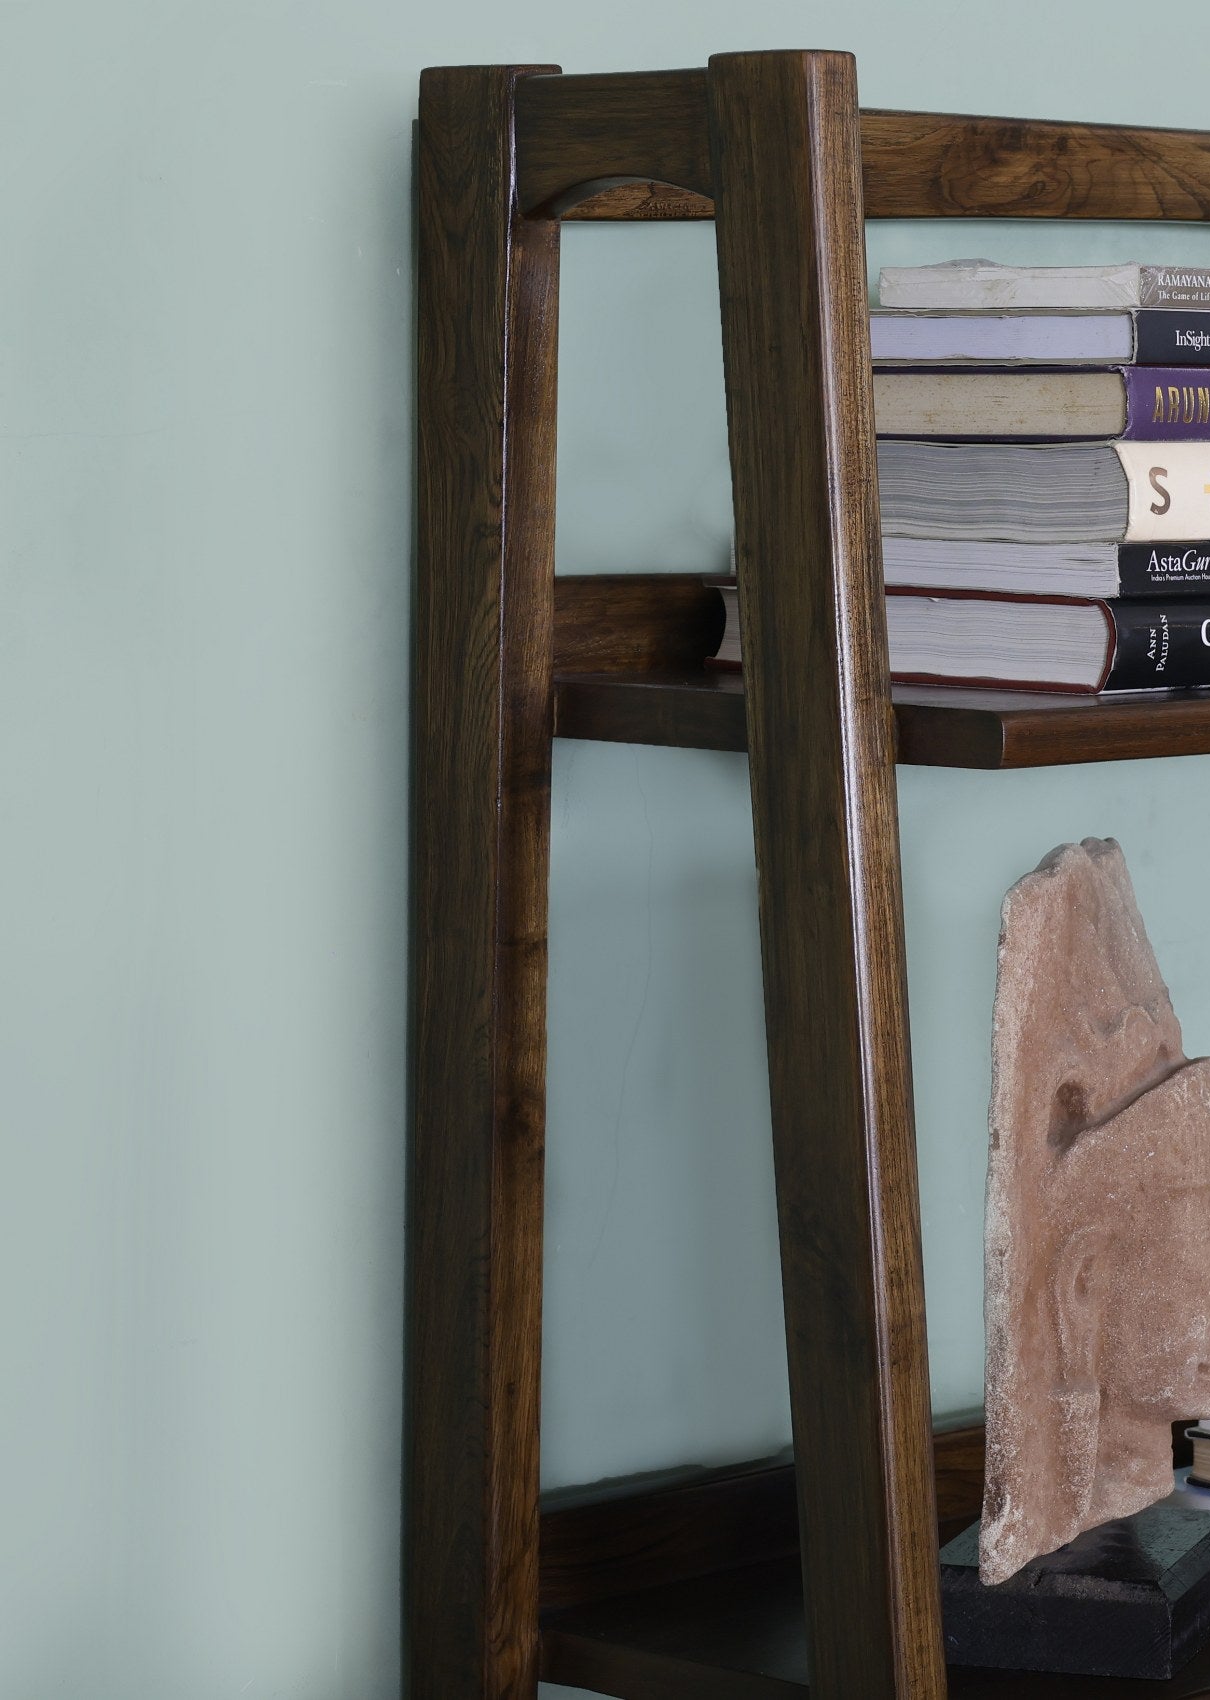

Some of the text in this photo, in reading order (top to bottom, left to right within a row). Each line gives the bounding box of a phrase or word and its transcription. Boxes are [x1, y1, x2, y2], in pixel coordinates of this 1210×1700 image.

[1158, 290, 1170, 300] The
[1172, 291, 1190, 301] Game
[1191, 292, 1199, 301] of
[1175, 331, 1210, 351] InSight
[1151, 573, 1165, 582] India's
[1166, 573, 1184, 581] Premium
[1185, 573, 1201, 581] Auction
[1146, 628, 1157, 660] ANN
[1155, 614, 1169, 672] PALUDAN
